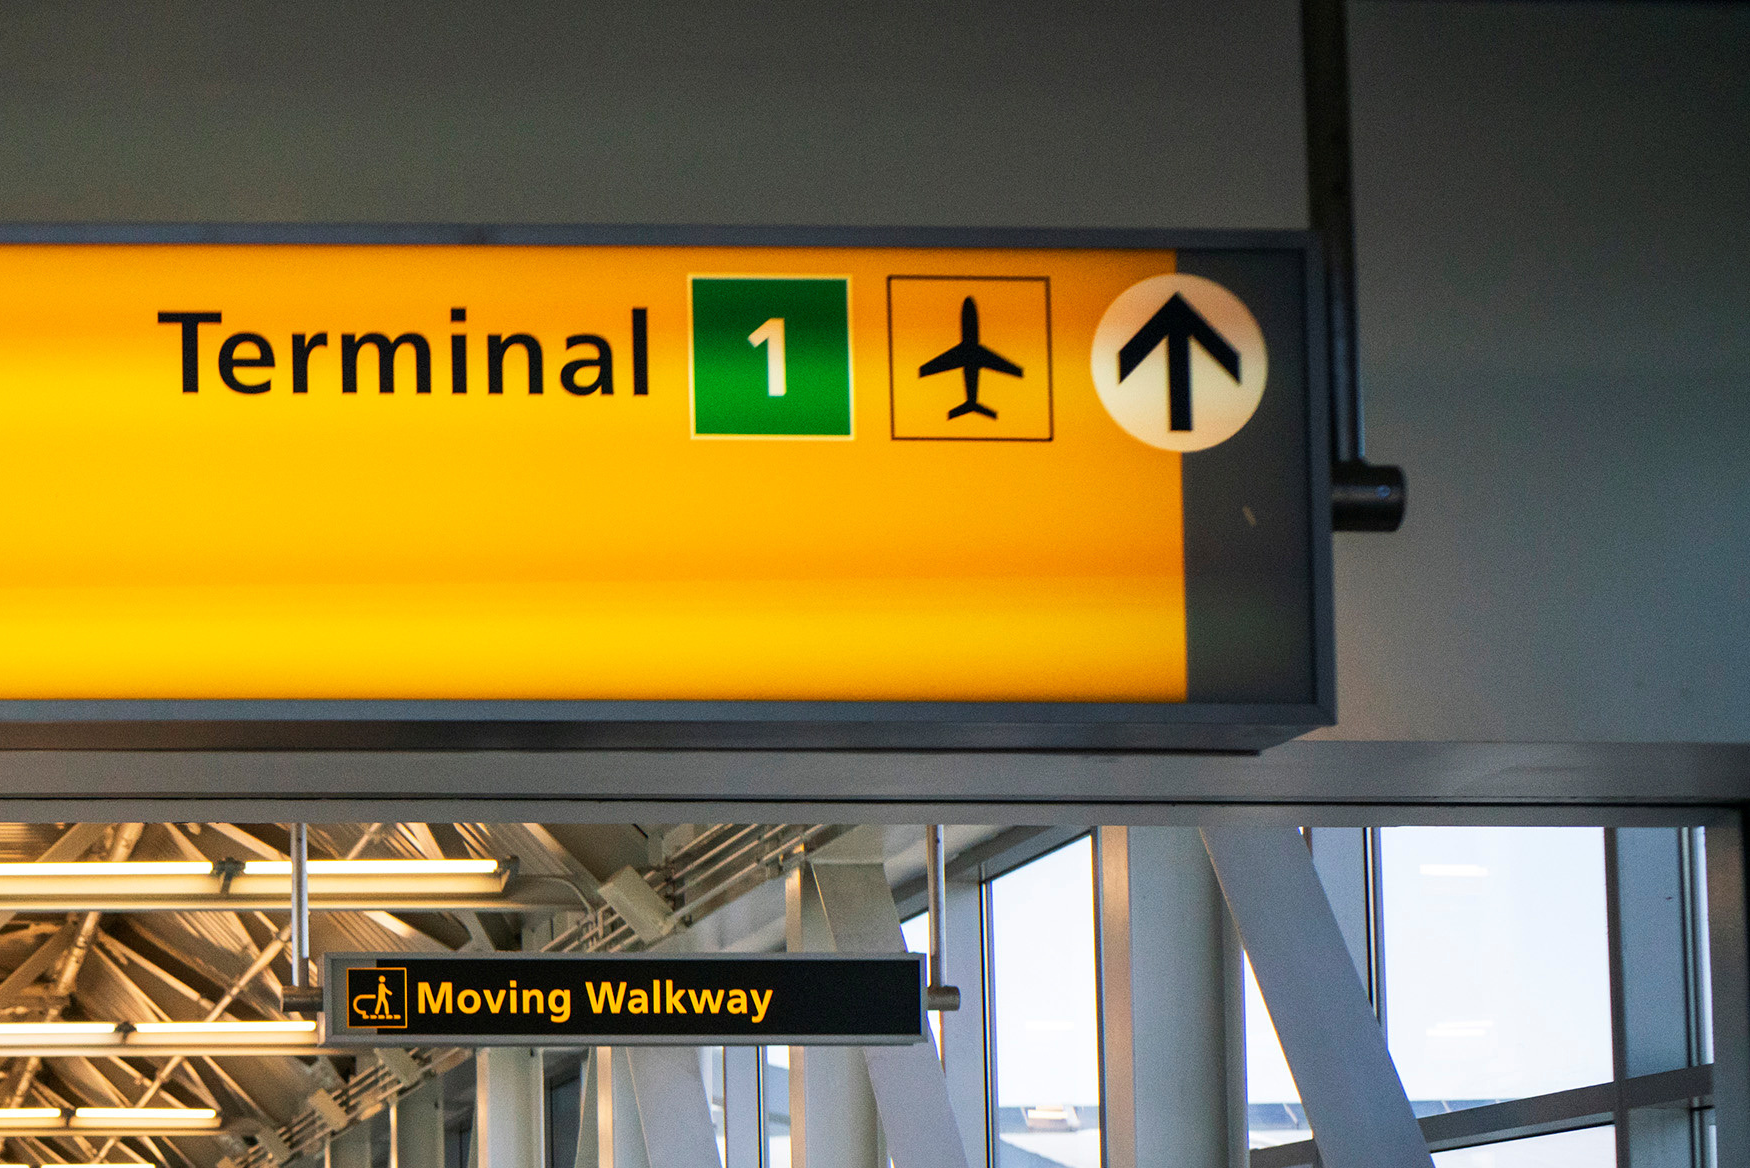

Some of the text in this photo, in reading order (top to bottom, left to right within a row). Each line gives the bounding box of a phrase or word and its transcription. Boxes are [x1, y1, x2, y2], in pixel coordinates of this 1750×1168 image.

[157, 306, 788, 398] Terminal 1
[416, 978, 774, 1024] Moving Walkway
